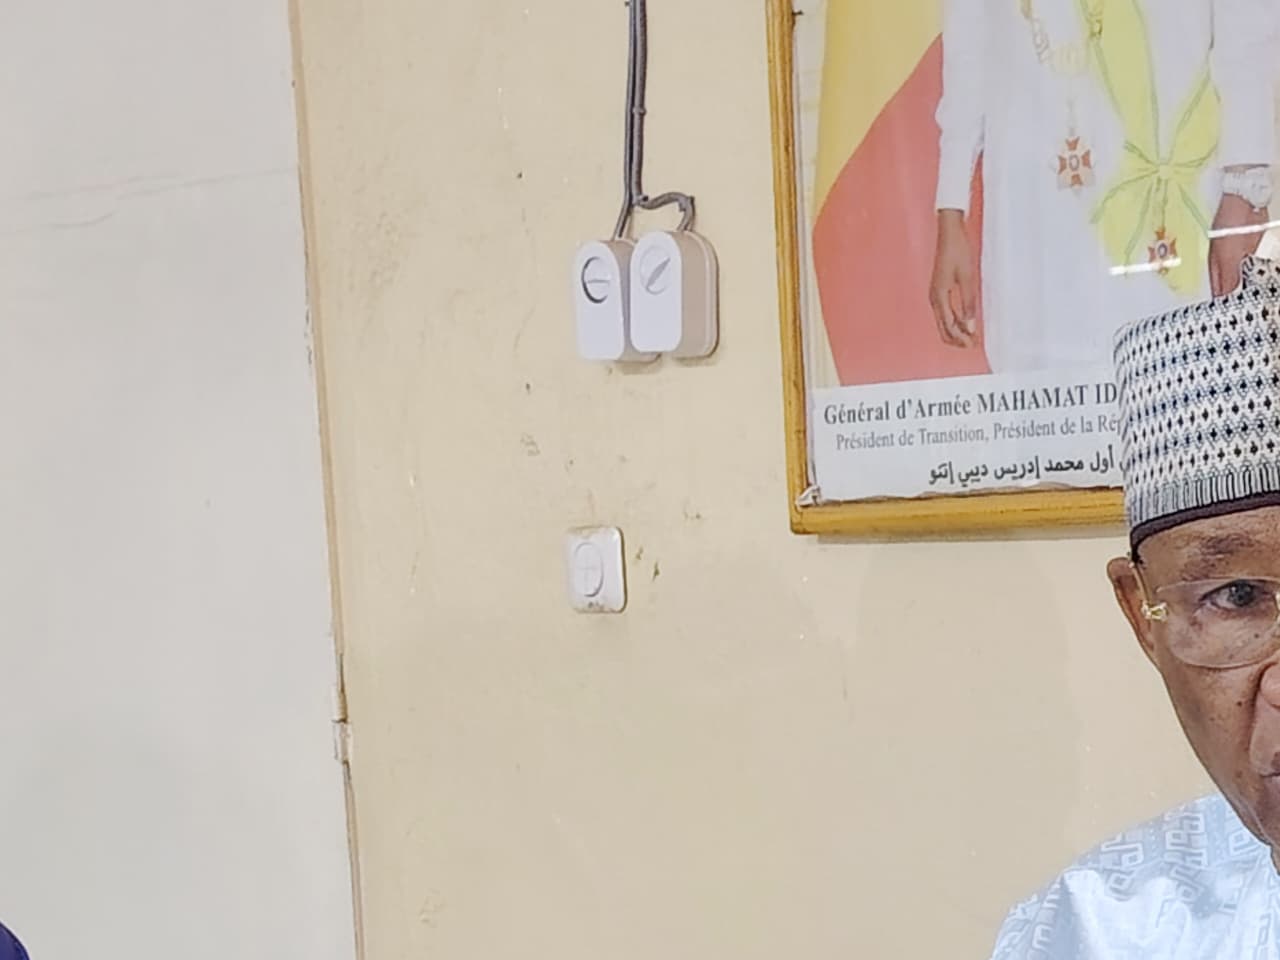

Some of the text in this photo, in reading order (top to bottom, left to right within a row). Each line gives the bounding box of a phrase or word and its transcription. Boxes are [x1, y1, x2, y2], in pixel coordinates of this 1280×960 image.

[824, 401, 890, 425] Général
[977, 383, 1088, 414] MAHAMAT
[836, 430, 894, 451] Président
[898, 429, 914, 446] de
[918, 424, 989, 445] Transition,
[993, 416, 1056, 440] Président
[1060, 417, 1077, 435] de
[1081, 415, 1094, 433] la
[994, 455, 1041, 480] إدريس
[1044, 457, 1085, 473] محمد
[1090, 444, 1115, 474] أول
